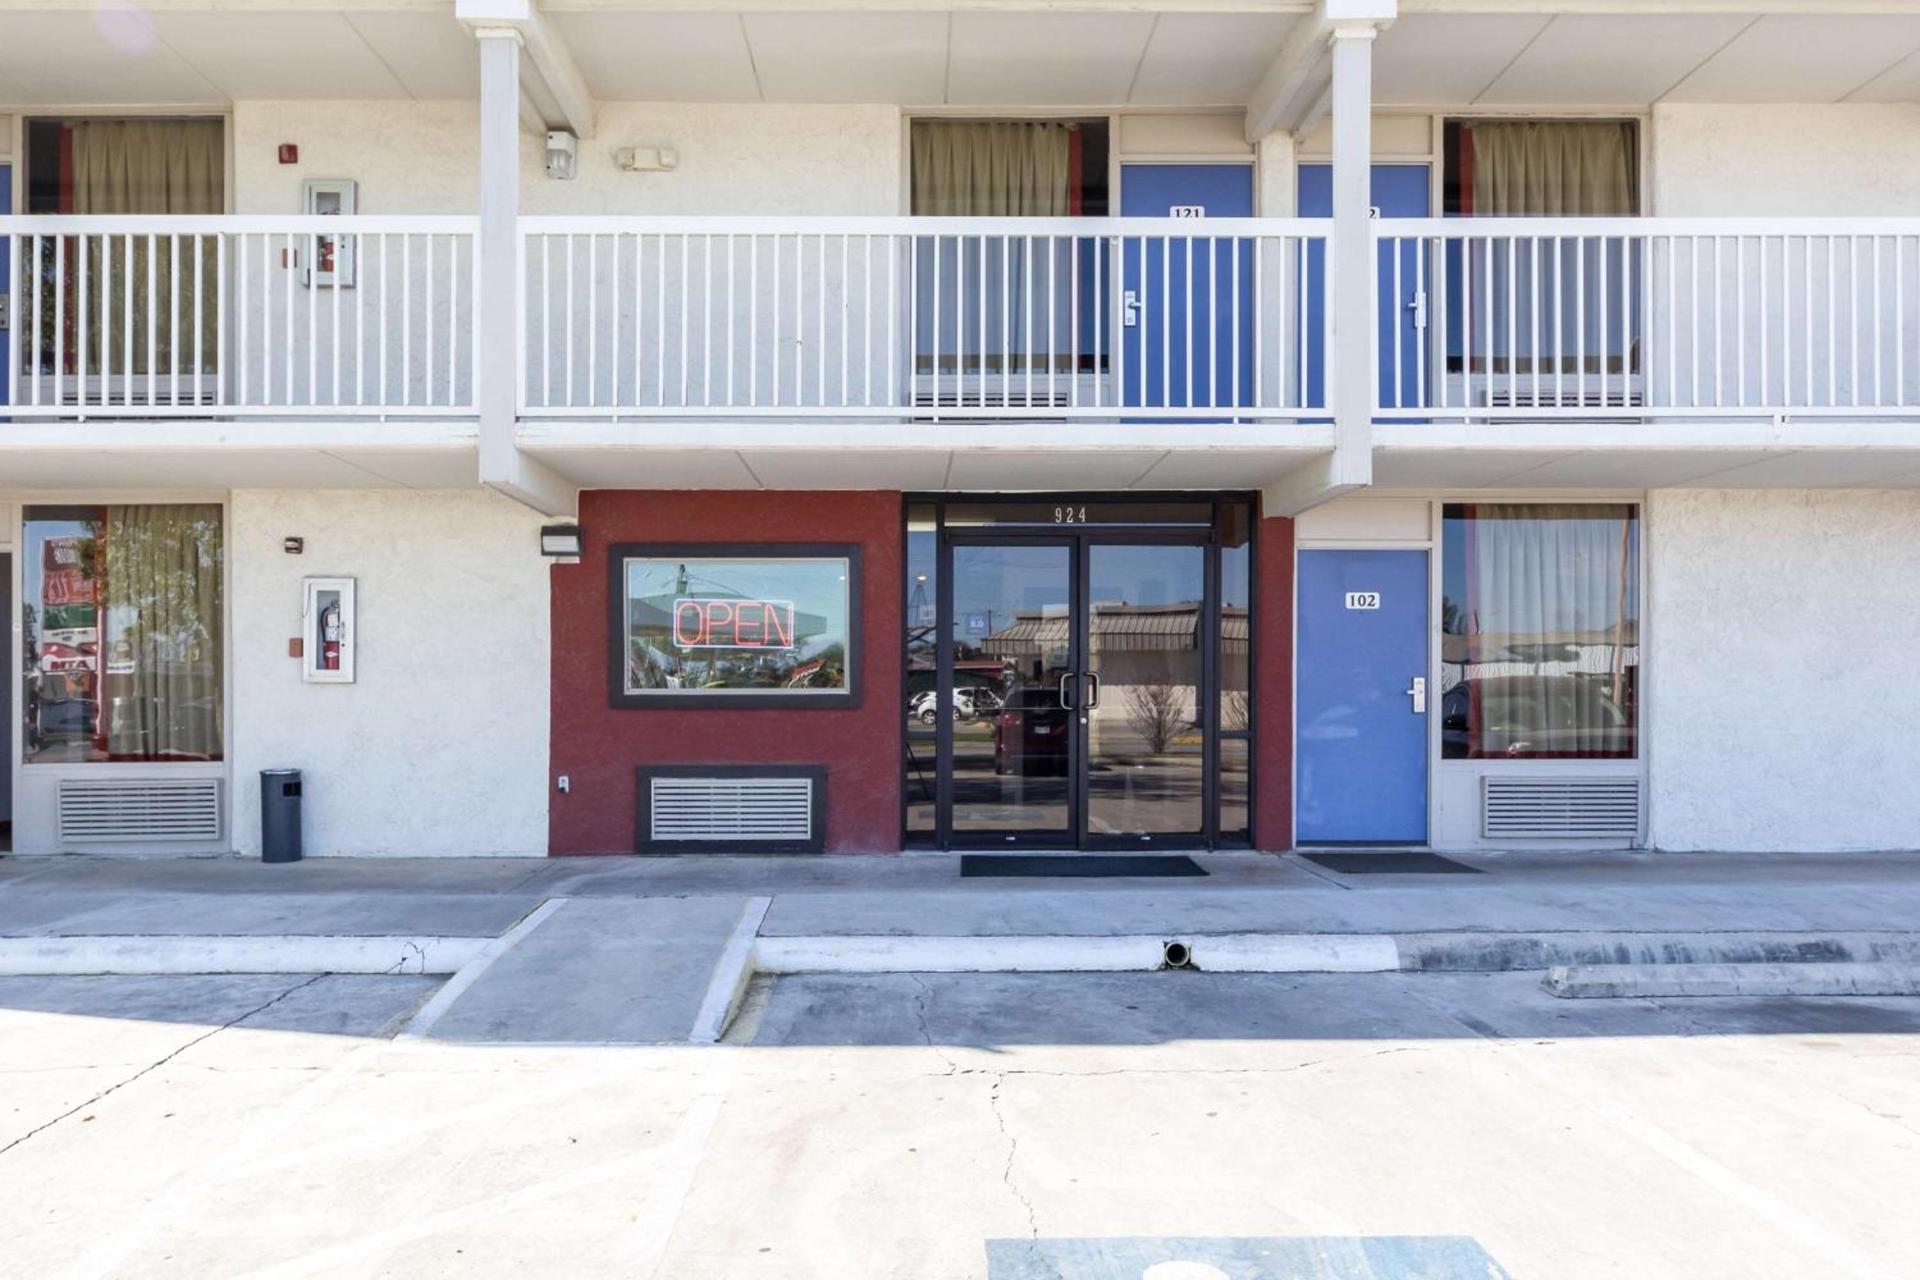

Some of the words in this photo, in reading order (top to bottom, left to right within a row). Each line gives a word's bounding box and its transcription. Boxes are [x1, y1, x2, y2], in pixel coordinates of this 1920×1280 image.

[1175, 208, 1199, 218] 121
[1055, 507, 1086, 523] 924
[1350, 594, 1376, 607] 102
[676, 601, 792, 646] OPEN
